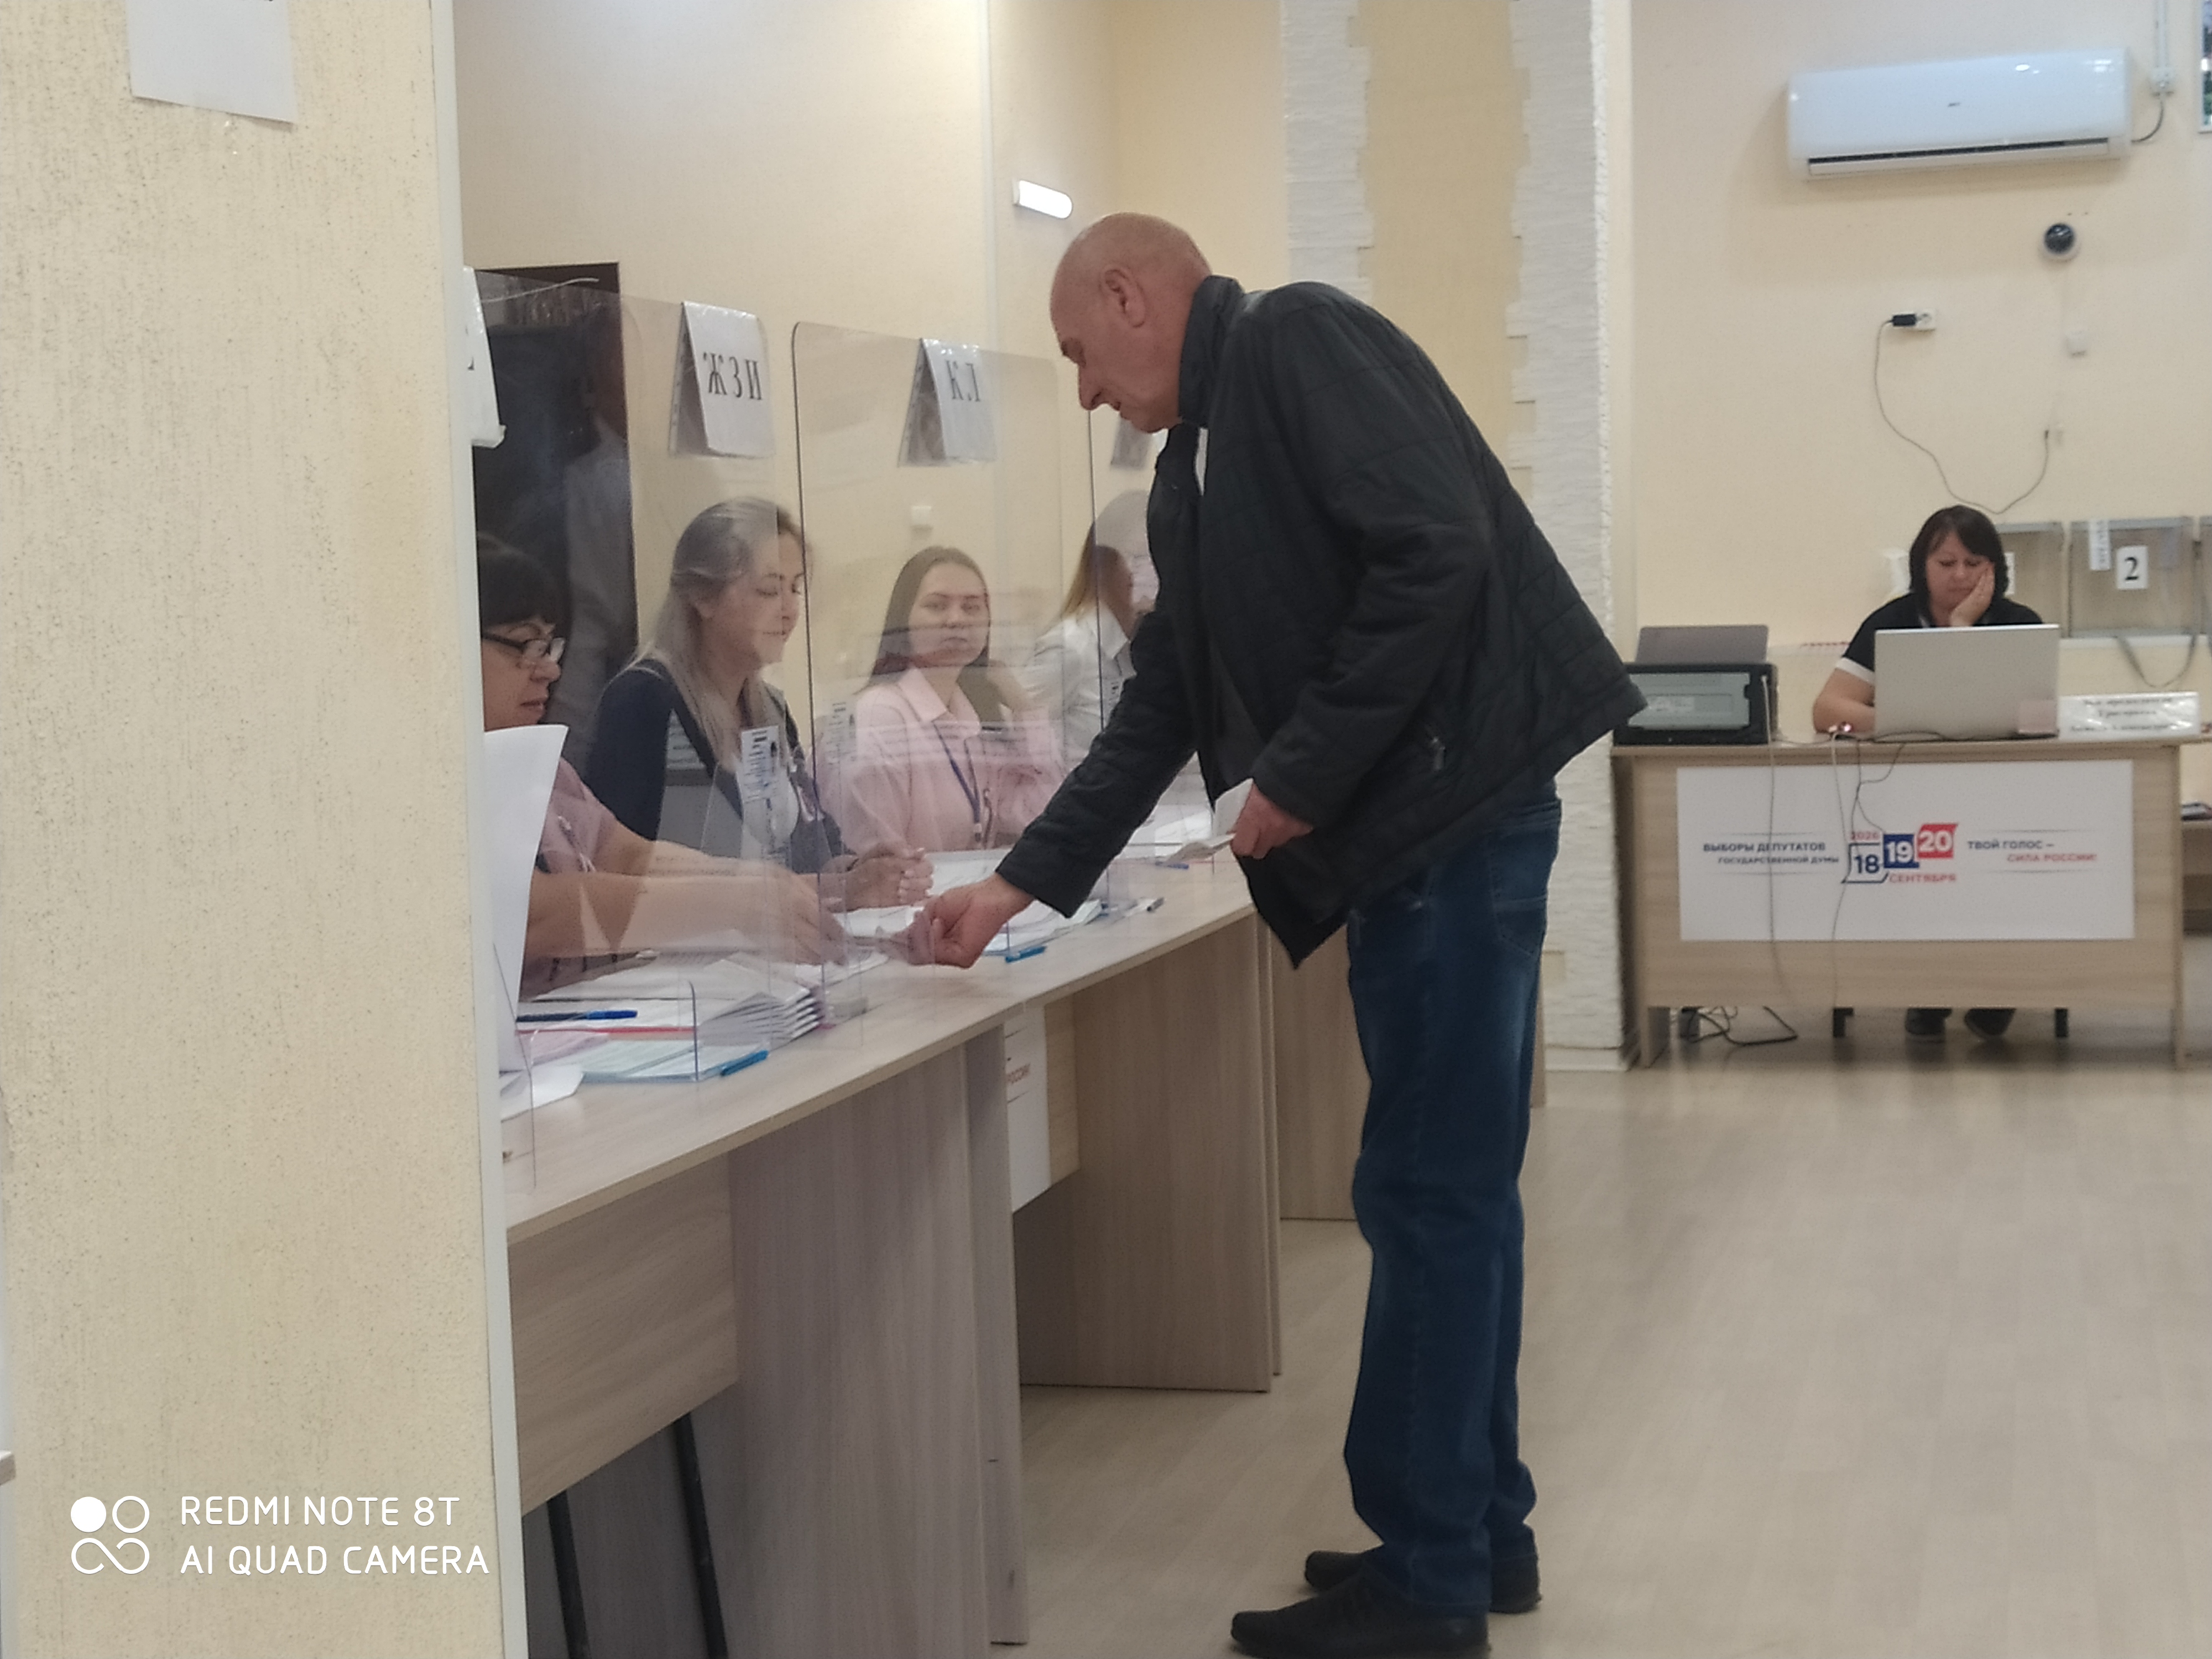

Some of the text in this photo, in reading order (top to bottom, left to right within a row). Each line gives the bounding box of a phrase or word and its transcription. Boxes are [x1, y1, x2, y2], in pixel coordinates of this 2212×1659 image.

[2124, 556, 2140, 581] 2
[1703, 842, 1827, 853] ВЫБОРЫ ДЕПУТАТОВ
[1967, 838, 2000, 850] ТВОЙ
[2002, 839, 2043, 850] ГОЛОС
[1854, 830, 1954, 874] 18 19 20
[2007, 853, 2041, 862] СИЛА
[1718, 856, 1839, 865] ГОСУДАРСТВЕННОЙ ДУМЫ
[1888, 873, 1957, 884] СЕНТЯБРЯ
